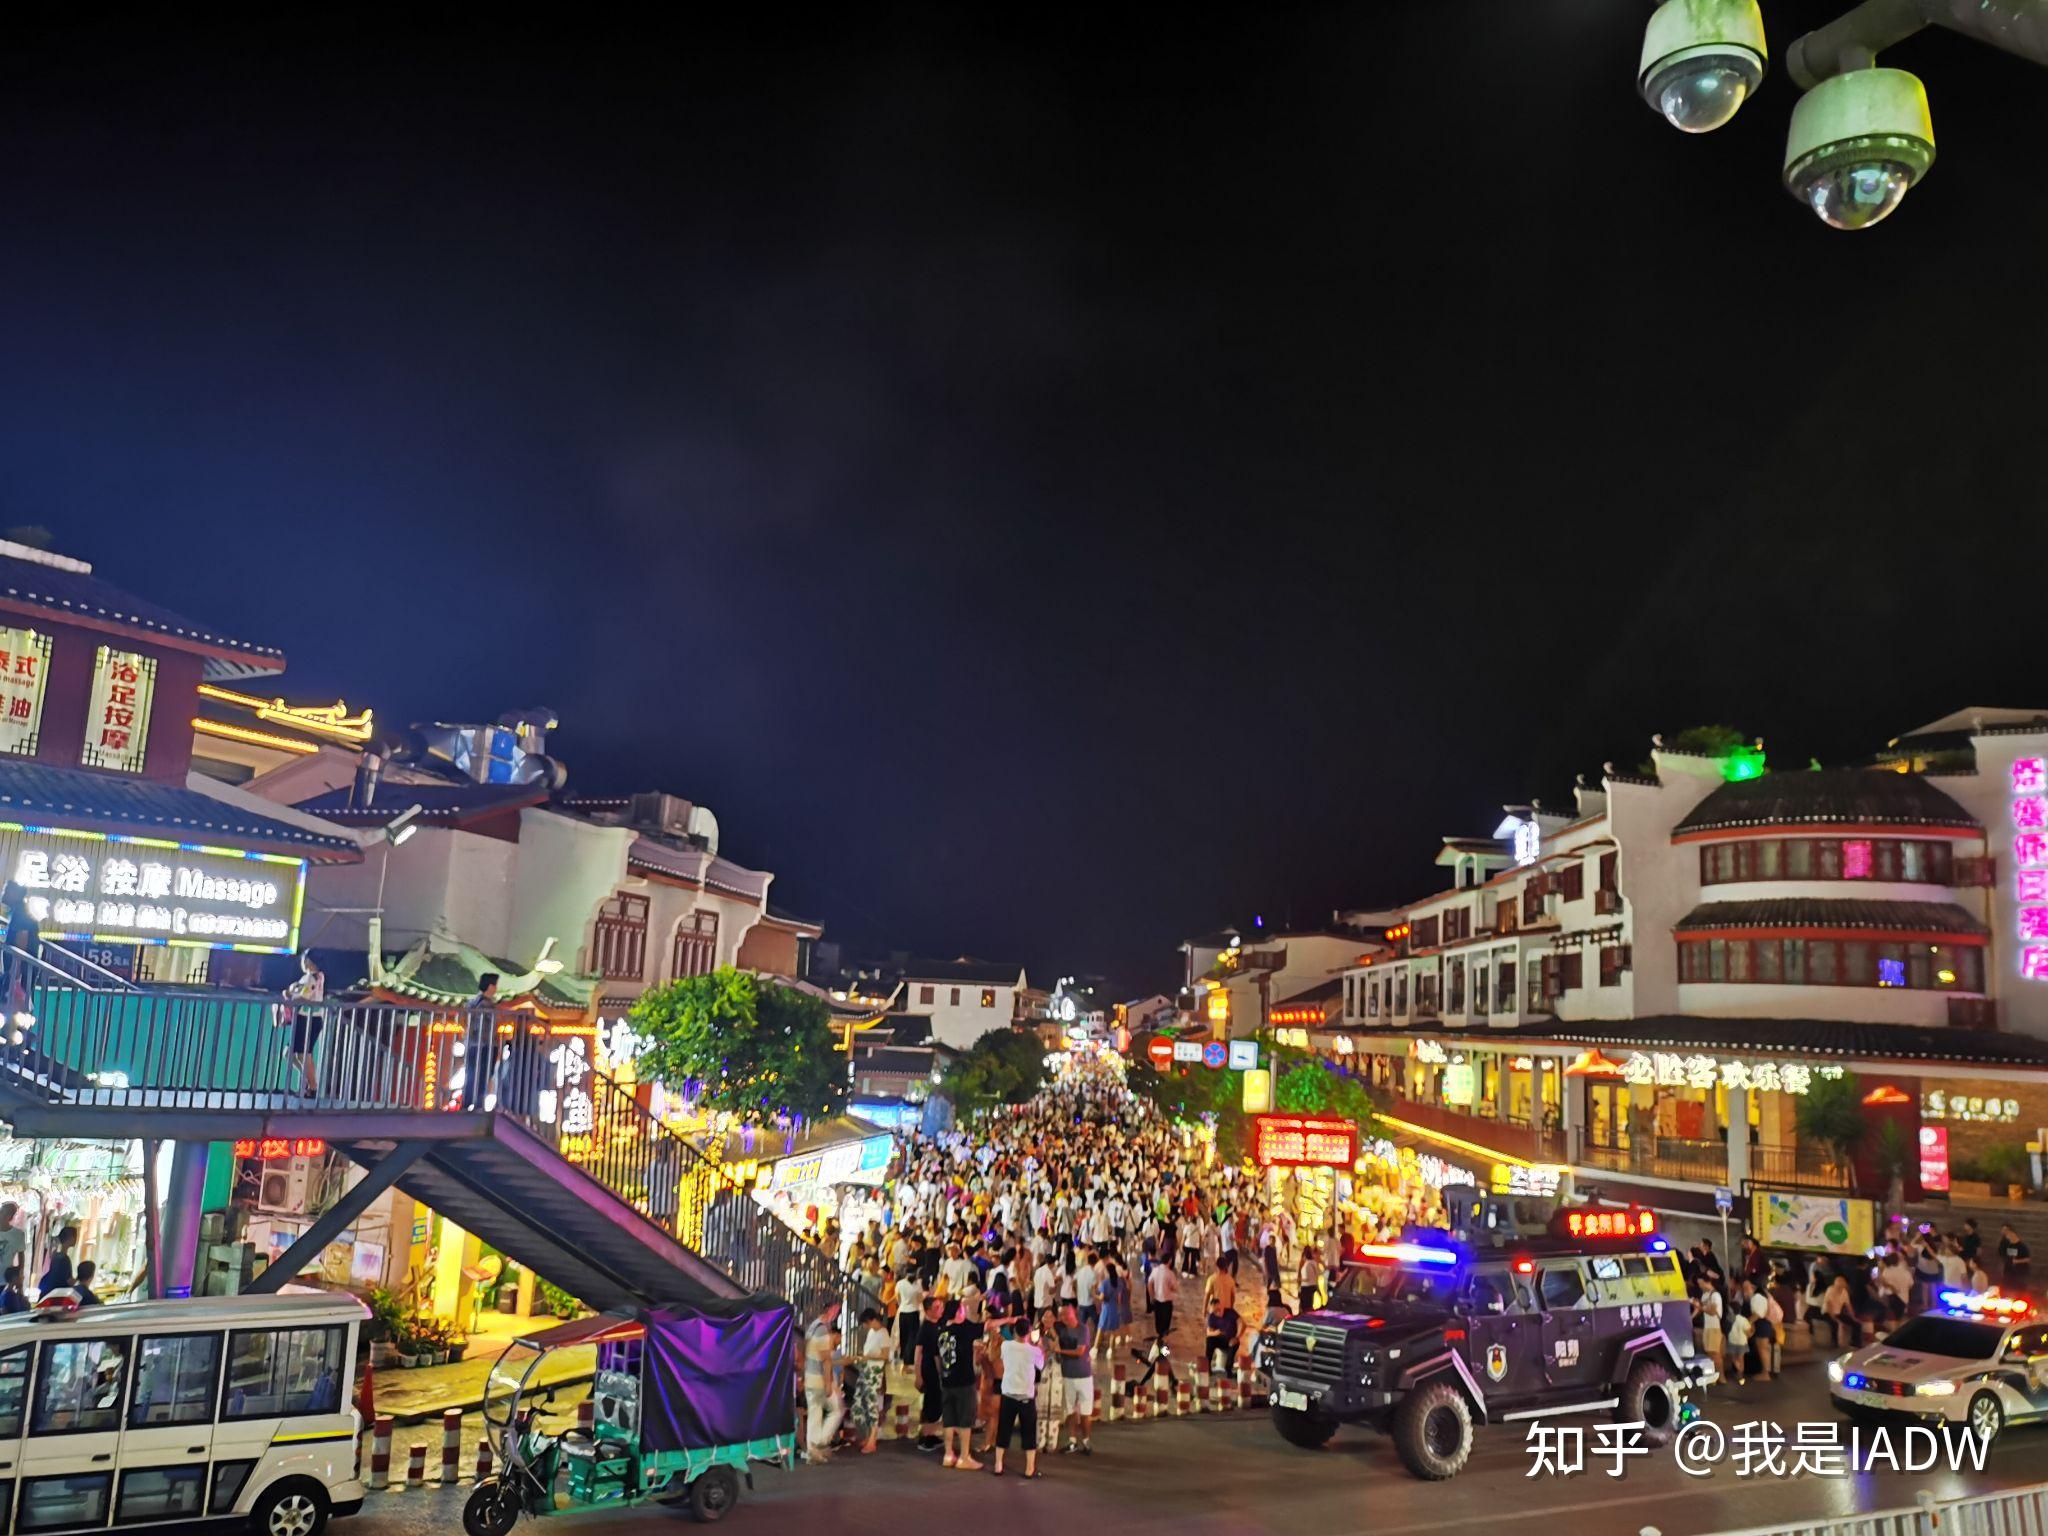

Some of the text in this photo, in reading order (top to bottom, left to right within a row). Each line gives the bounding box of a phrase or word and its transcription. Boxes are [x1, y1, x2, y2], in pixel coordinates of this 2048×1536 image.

[0, 694, 32, 719] 油
[100, 660, 139, 750] 浴足按摩
[175, 866, 278, 908] Massage
